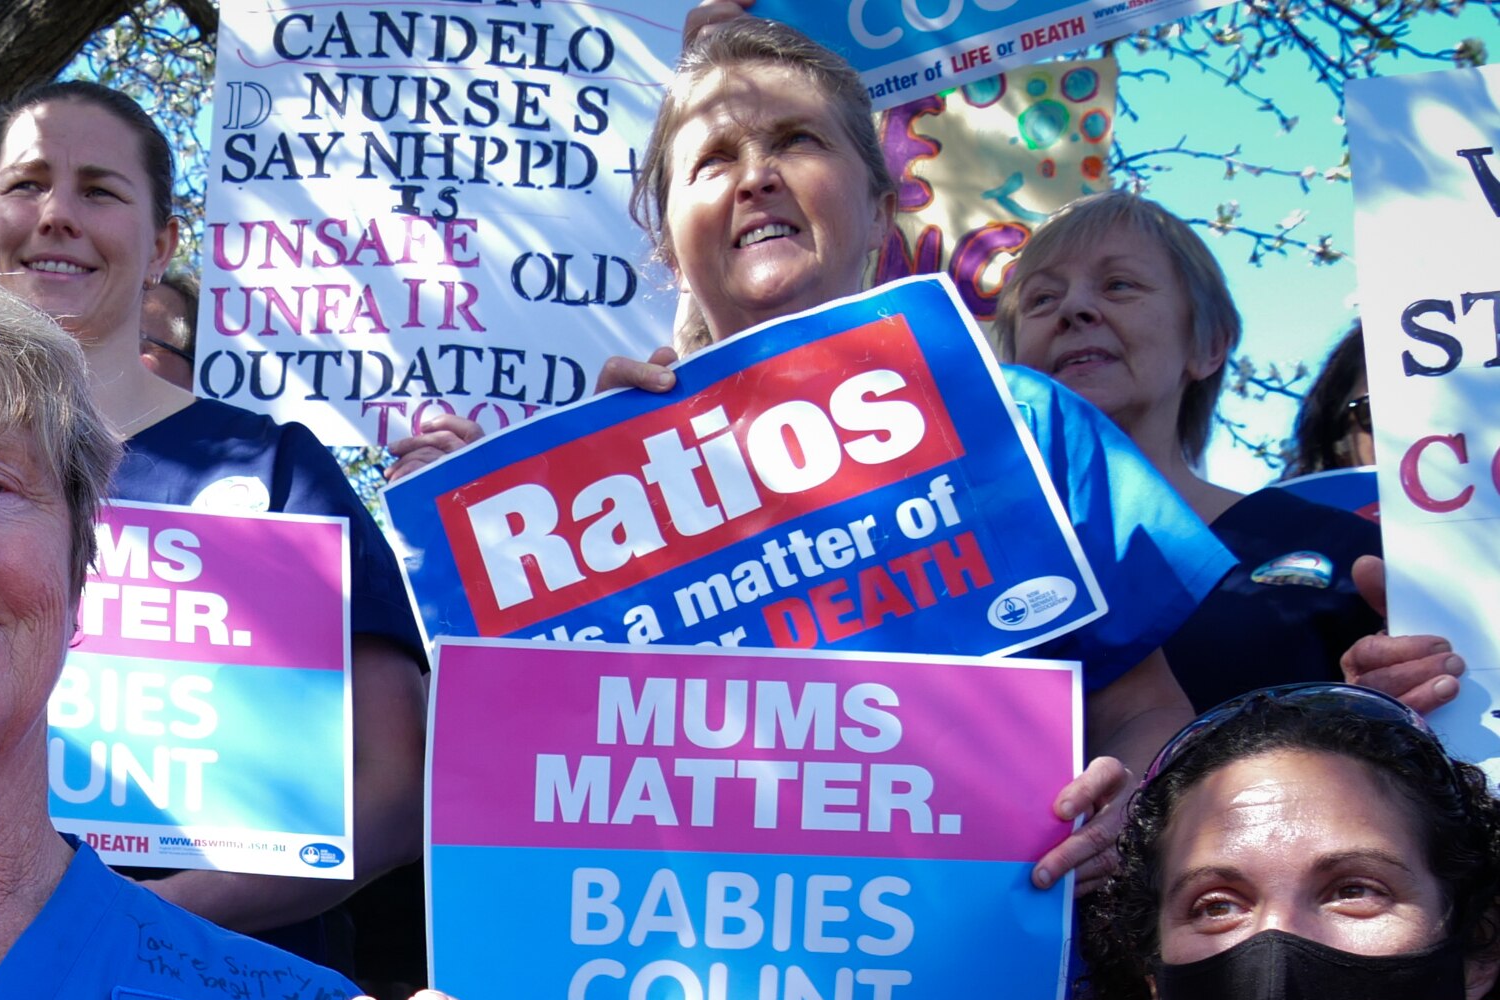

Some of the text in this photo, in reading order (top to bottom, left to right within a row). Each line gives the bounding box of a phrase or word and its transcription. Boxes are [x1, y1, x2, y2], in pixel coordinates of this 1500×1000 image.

[272, 10, 615, 74] CANDELO
[923, 61, 943, 83] of
[950, 46, 992, 74] LIFE
[996, 40, 1016, 57] or
[1019, 16, 1086, 52] DEATH
[302, 72, 610, 135] NURSES
[222, 130, 344, 184] SAY
[389, 184, 462, 223] IS
[208, 214, 481, 272] UNSAFE
[209, 278, 487, 337] UNFAIR
[510, 250, 638, 307] OLD
[199, 343, 587, 407] OUTDATED
[466, 368, 926, 611] Ratios
[623, 473, 963, 645] a matter of
[760, 530, 995, 649] DEATH
[596, 675, 903, 753] MUMS
[533, 753, 962, 835] MATTER.
[86, 832, 149, 853] DEATH
[569, 867, 915, 957] BABIES
